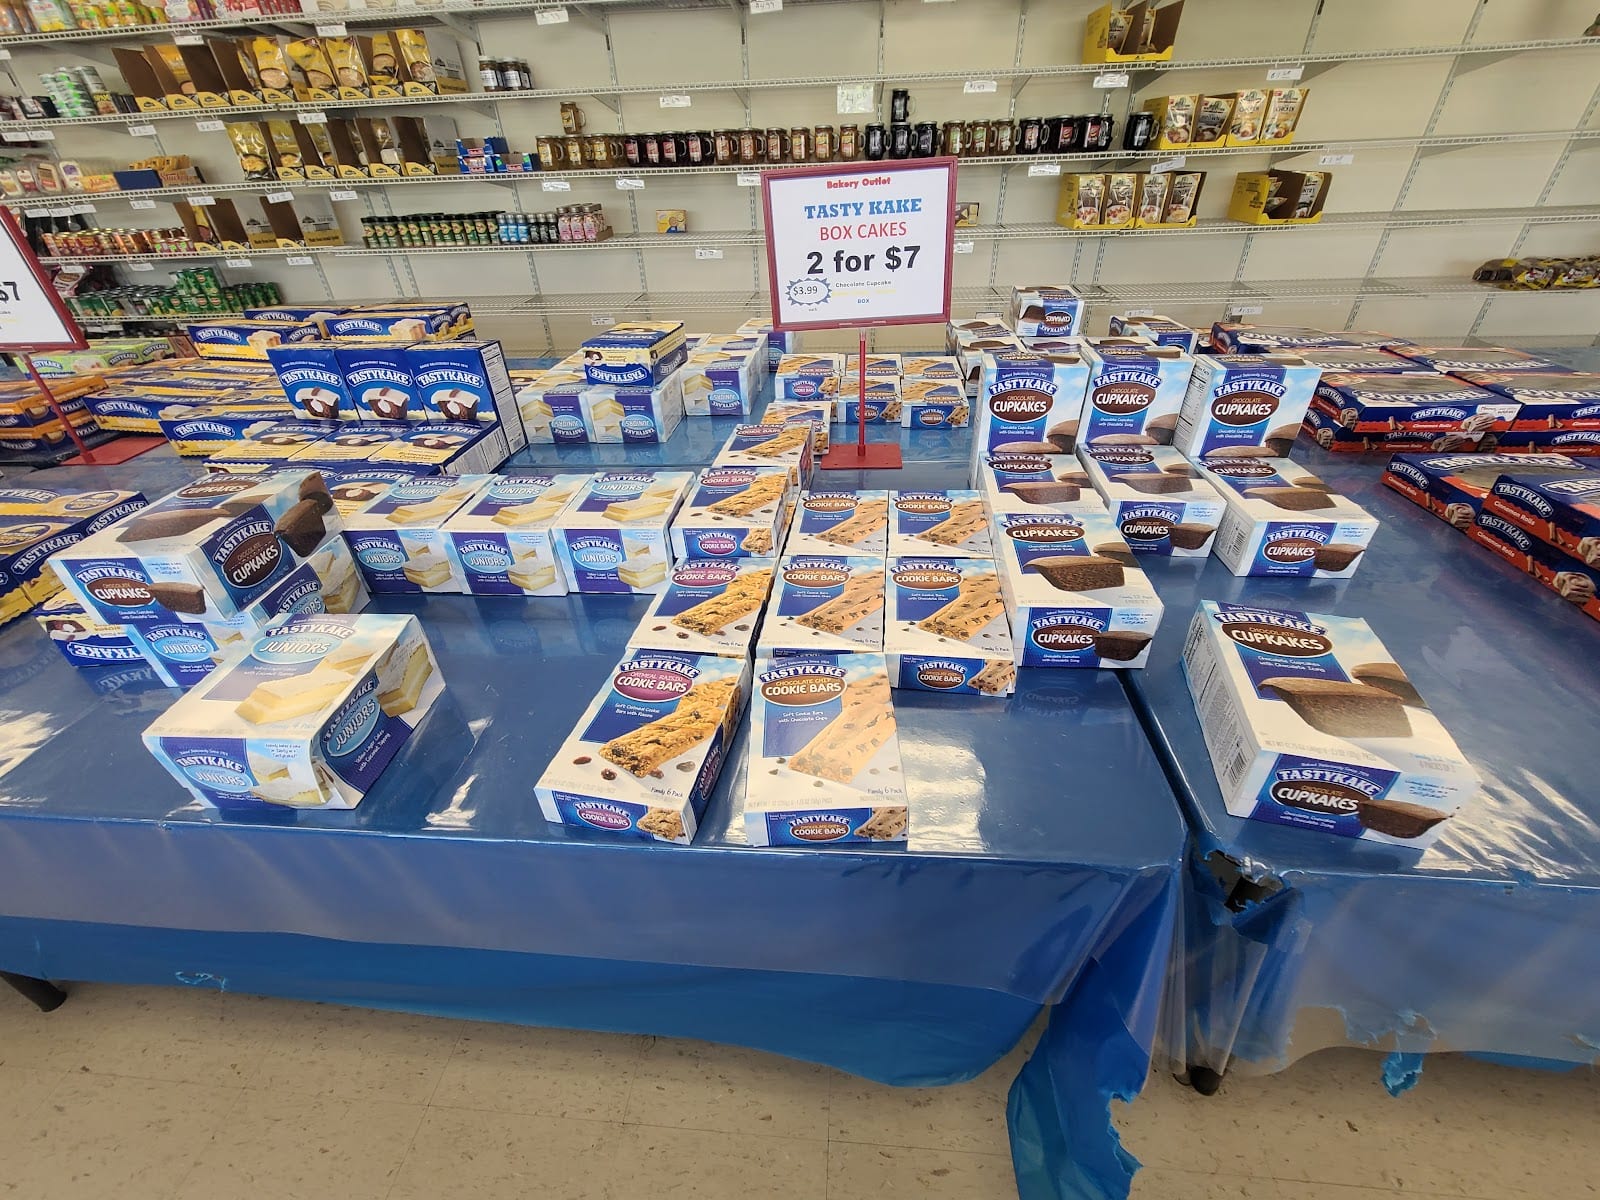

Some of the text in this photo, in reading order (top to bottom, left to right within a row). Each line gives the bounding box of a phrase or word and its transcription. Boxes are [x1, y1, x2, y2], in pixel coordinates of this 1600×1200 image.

[826, 177, 891, 189] Bakery Outlet
[804, 198, 922, 219] TASTY KAKE
[820, 221, 907, 241] BOX CAKES
[807, 245, 921, 275] 2 for $7
[793, 286, 818, 296] $3.99
[335, 320, 382, 333] TASTYKAKE
[198, 328, 241, 342] TASTYKAKE
[289, 327, 319, 343] TASTYKAKE
[282, 370, 339, 385] TASTYKAKE
[349, 370, 409, 385] TASTYKAKE
[418, 370, 482, 386] TASTYKAKE
[591, 368, 647, 383] TASTYKAKE
[1094, 371, 1161, 388] TASTYKAKE
[989, 378, 1057, 395] TASTYKAKE
[1216, 380, 1286, 397] TASTYKAKE
[1096, 393, 1149, 405] CUPKAKES
[97, 402, 150, 416] TASTYKAKE
[993, 401, 1047, 413] CUPKAKES
[1215, 403, 1272, 416] CUPKAKES
[1413, 409, 1466, 419] TASTYKAKE
[175, 421, 234, 436] TASTYKAKE
[418, 425, 480, 435] TASTYKAKE
[1095, 454, 1150, 462] CUPKAKES
[1215, 467, 1272, 475] CUPKAKES
[1391, 462, 1428, 488] TASTYKAKE
[495, 478, 554, 487] TASTYKAKE
[597, 475, 655, 483] TASTYKAKE
[495, 487, 541, 495] JUNIORS
[804, 494, 861, 502] TASTYKAKE
[895, 495, 953, 503] TASTYKAKE
[1498, 484, 1551, 517] TASTYKAKE
[88, 502, 147, 535] TASTYKAKE
[1122, 508, 1177, 522] TASTYKAKE
[1494, 500, 1536, 526] Cinnamon Rolls
[1002, 516, 1082, 528] TASTYKAKE
[698, 532, 736, 541] TASTYKAKE
[1012, 529, 1079, 538] CUPKAKES
[1123, 525, 1169, 535] CUPKAKES
[1267, 529, 1327, 543] TASTYKAKE
[1481, 515, 1531, 549] TASTYKAKE
[214, 522, 270, 563] TASTYKAKE
[354, 541, 401, 552] TASTYKAKE
[571, 540, 620, 551] TASTYKAKE
[1477, 531, 1515, 557] Cinnamon Rolls
[13, 534, 81, 572] TASTYKAKE
[460, 544, 508, 555] TASTYKAKE
[1267, 546, 1315, 557] CUPKAKES
[232, 545, 279, 583] CUPKAKES
[366, 555, 400, 563] JUNIORS
[470, 557, 505, 567] JUNIORS
[580, 554, 617, 563] JUNIORS
[675, 562, 740, 571] TASTYKAKE
[784, 562, 852, 572] TASTYKAKE
[893, 563, 962, 573] TASTYKAKE
[78, 567, 144, 583] TASTYKAKE
[674, 573, 733, 581] COOKIE BARS
[786, 573, 818, 581] COOKIE
[896, 575, 959, 583] COOKIE BARS
[94, 587, 151, 600] CUPKAKES
[1034, 614, 1103, 629] TASTYKAKE
[1216, 612, 1321, 635] TASTYKAKE
[146, 628, 206, 642] TASTYKAKE
[269, 624, 354, 638] TASTYKAKE
[1248, 626, 1296, 637] CHOCOLATE
[1037, 634, 1093, 644] CUPKAKES
[1231, 630, 1325, 651] CUPKAKES
[162, 644, 207, 654] JUNIORS
[259, 641, 331, 654] JUNIORS
[622, 659, 700, 678] TASTYKAKE
[760, 665, 847, 682] TASTYKAKE
[918, 661, 966, 674] TASTYKAKE
[630, 672, 657, 680] OATMEAL
[776, 678, 813, 686] CHOCOLATE
[920, 674, 945, 682] COOKIE
[617, 676, 688, 693] COOKIE BARS
[765, 682, 841, 697] COOKIE BARS
[324, 680, 374, 738] TASTYKAKE
[626, 704, 644, 712] Oatmeal
[645, 706, 660, 714] Cookie
[336, 699, 375, 750] JUNIORS
[176, 756, 243, 773] TASTYKAKE
[195, 771, 246, 786] JUNIORS
[1277, 769, 1381, 795] TASTYKAKE
[650, 786, 666, 798] Family
[672, 789, 684, 798] Pack
[884, 786, 890, 794] 6
[1301, 785, 1344, 796] CHOCOLATE
[1276, 787, 1359, 811] CUPKAKES
[575, 802, 630, 817] TASTYKAKE
[581, 812, 629, 827] COOKIE BARS
[789, 814, 850, 826] TASTYKAKE
